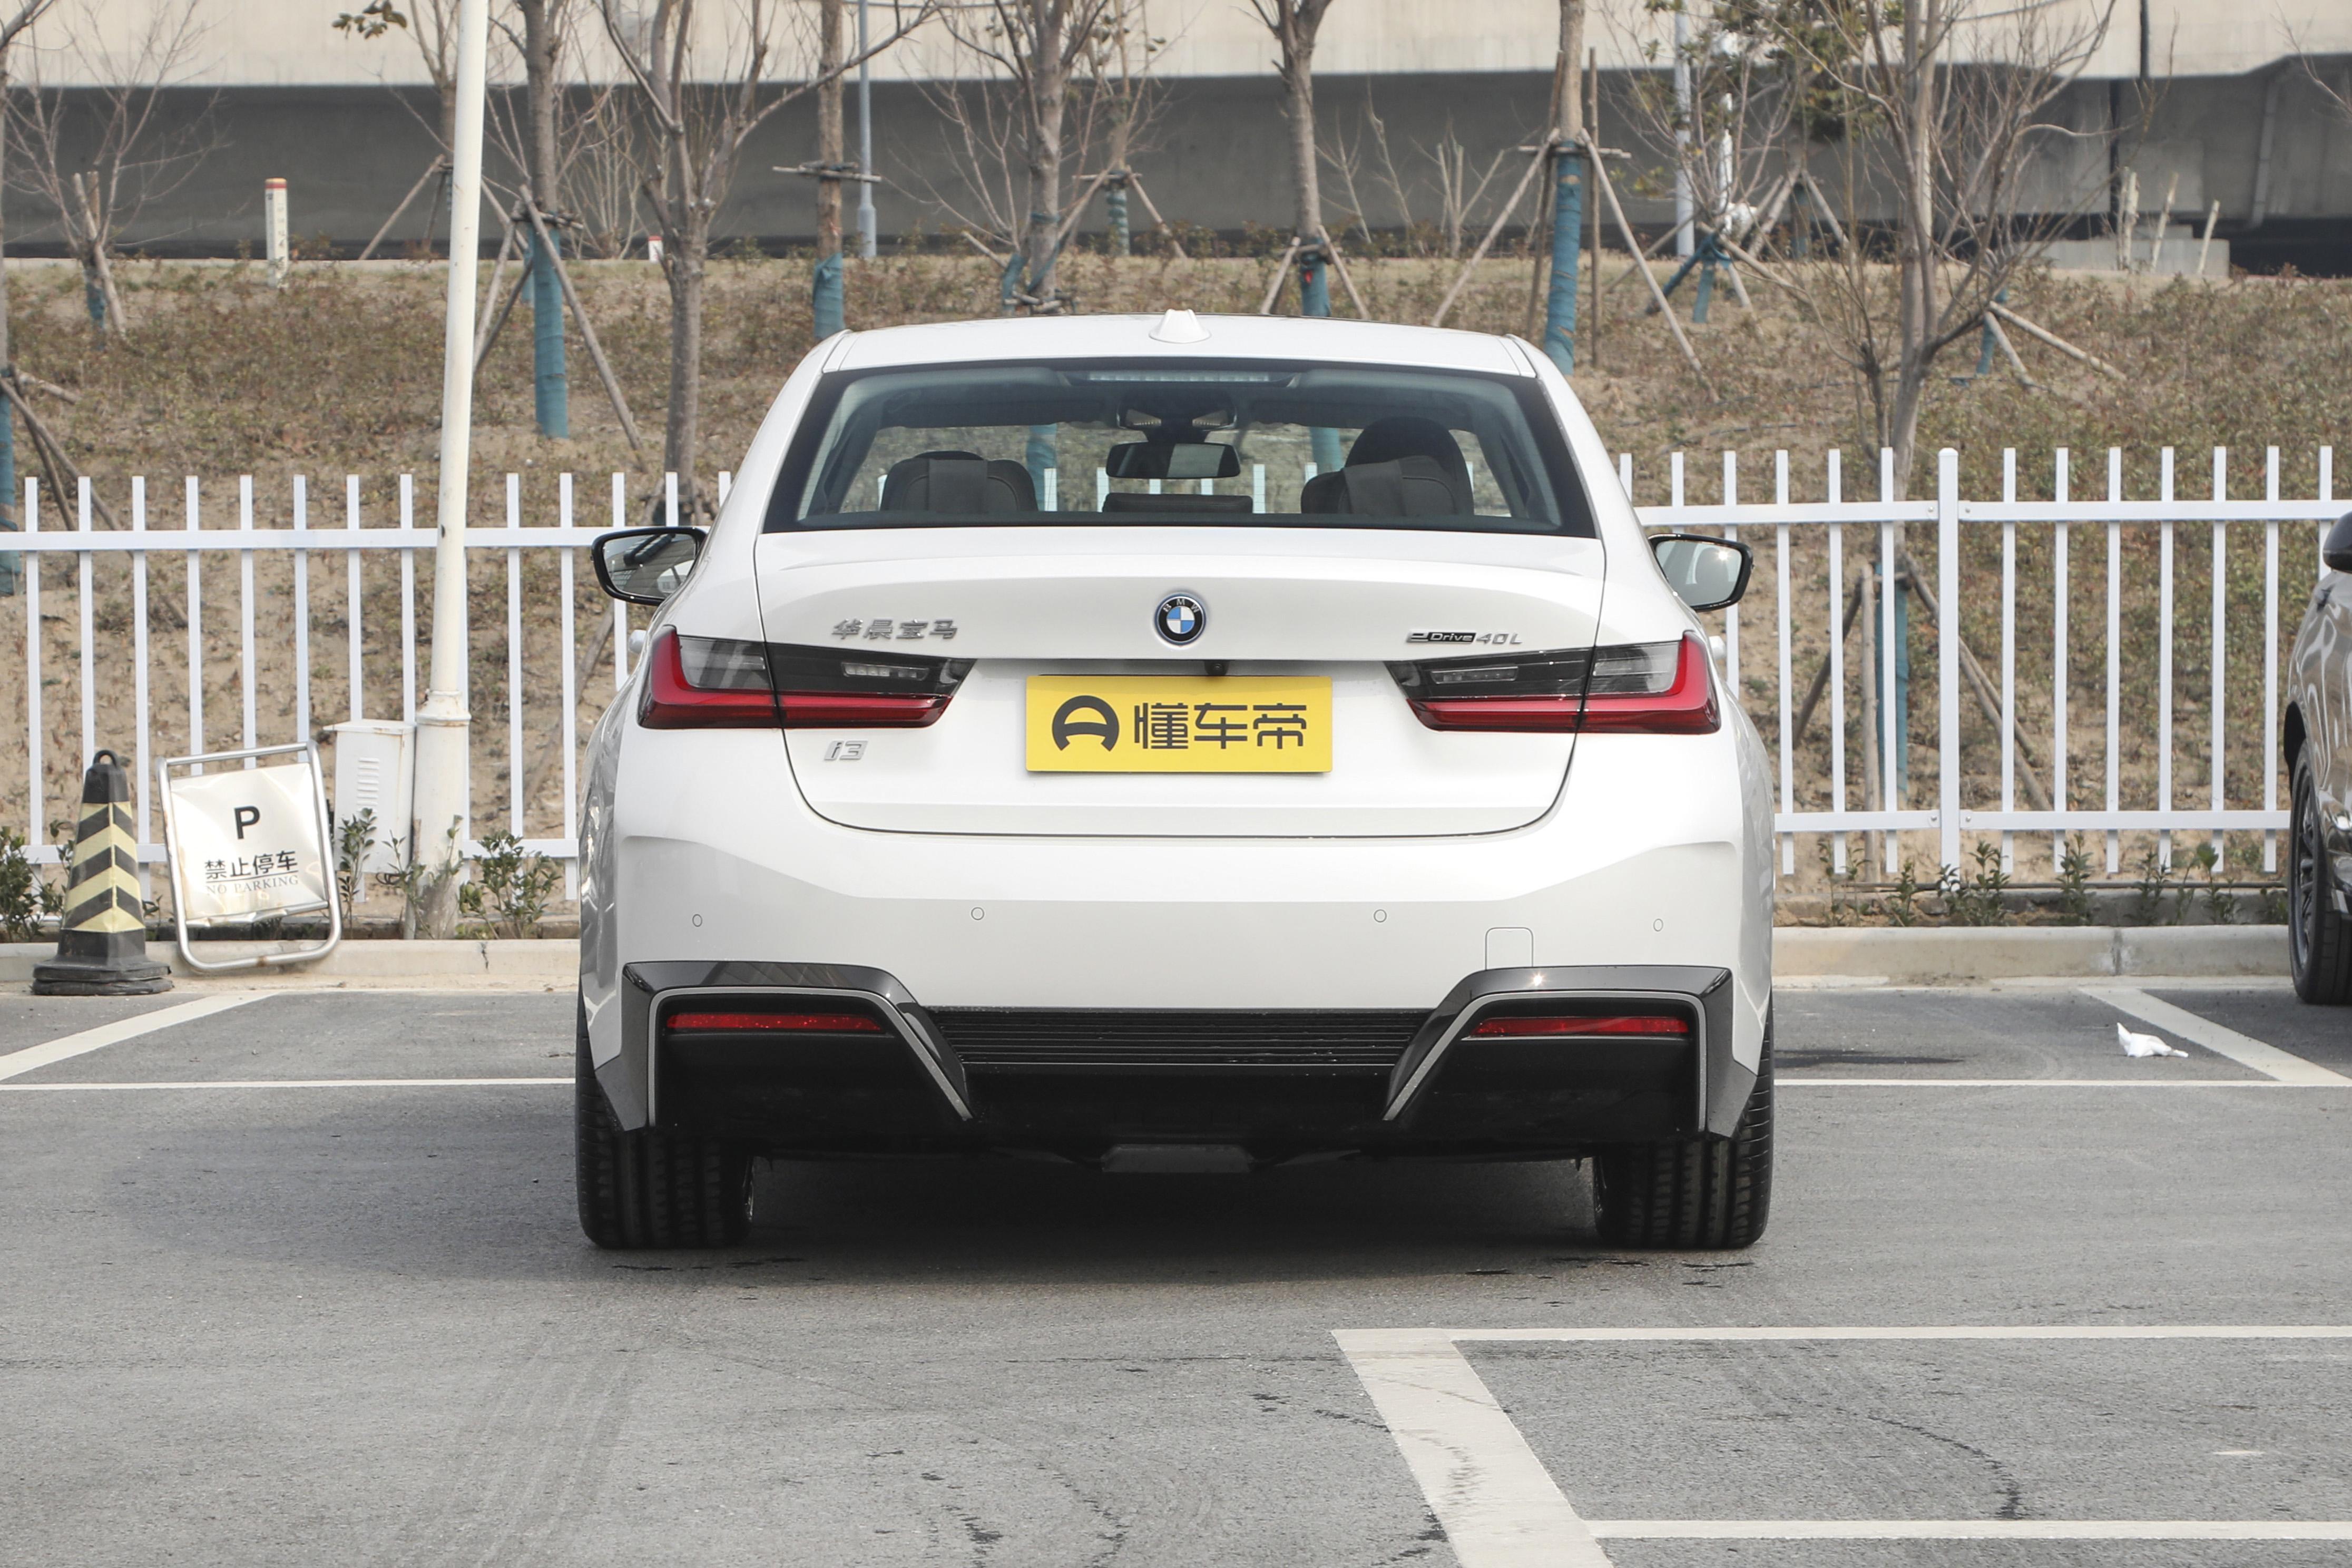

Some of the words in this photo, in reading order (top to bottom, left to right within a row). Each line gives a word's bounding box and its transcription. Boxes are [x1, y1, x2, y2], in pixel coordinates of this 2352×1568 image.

[1162, 598, 1200, 613] BMW
[831, 618, 958, 639] 华晨宝马
[1134, 702, 1307, 749] 懂车帝
[824, 740, 868, 761] i3
[234, 806, 260, 839] P
[204, 850, 298, 879] 禁止停车
[207, 884, 227, 895] NO
[234, 875, 299, 893] PARKING
